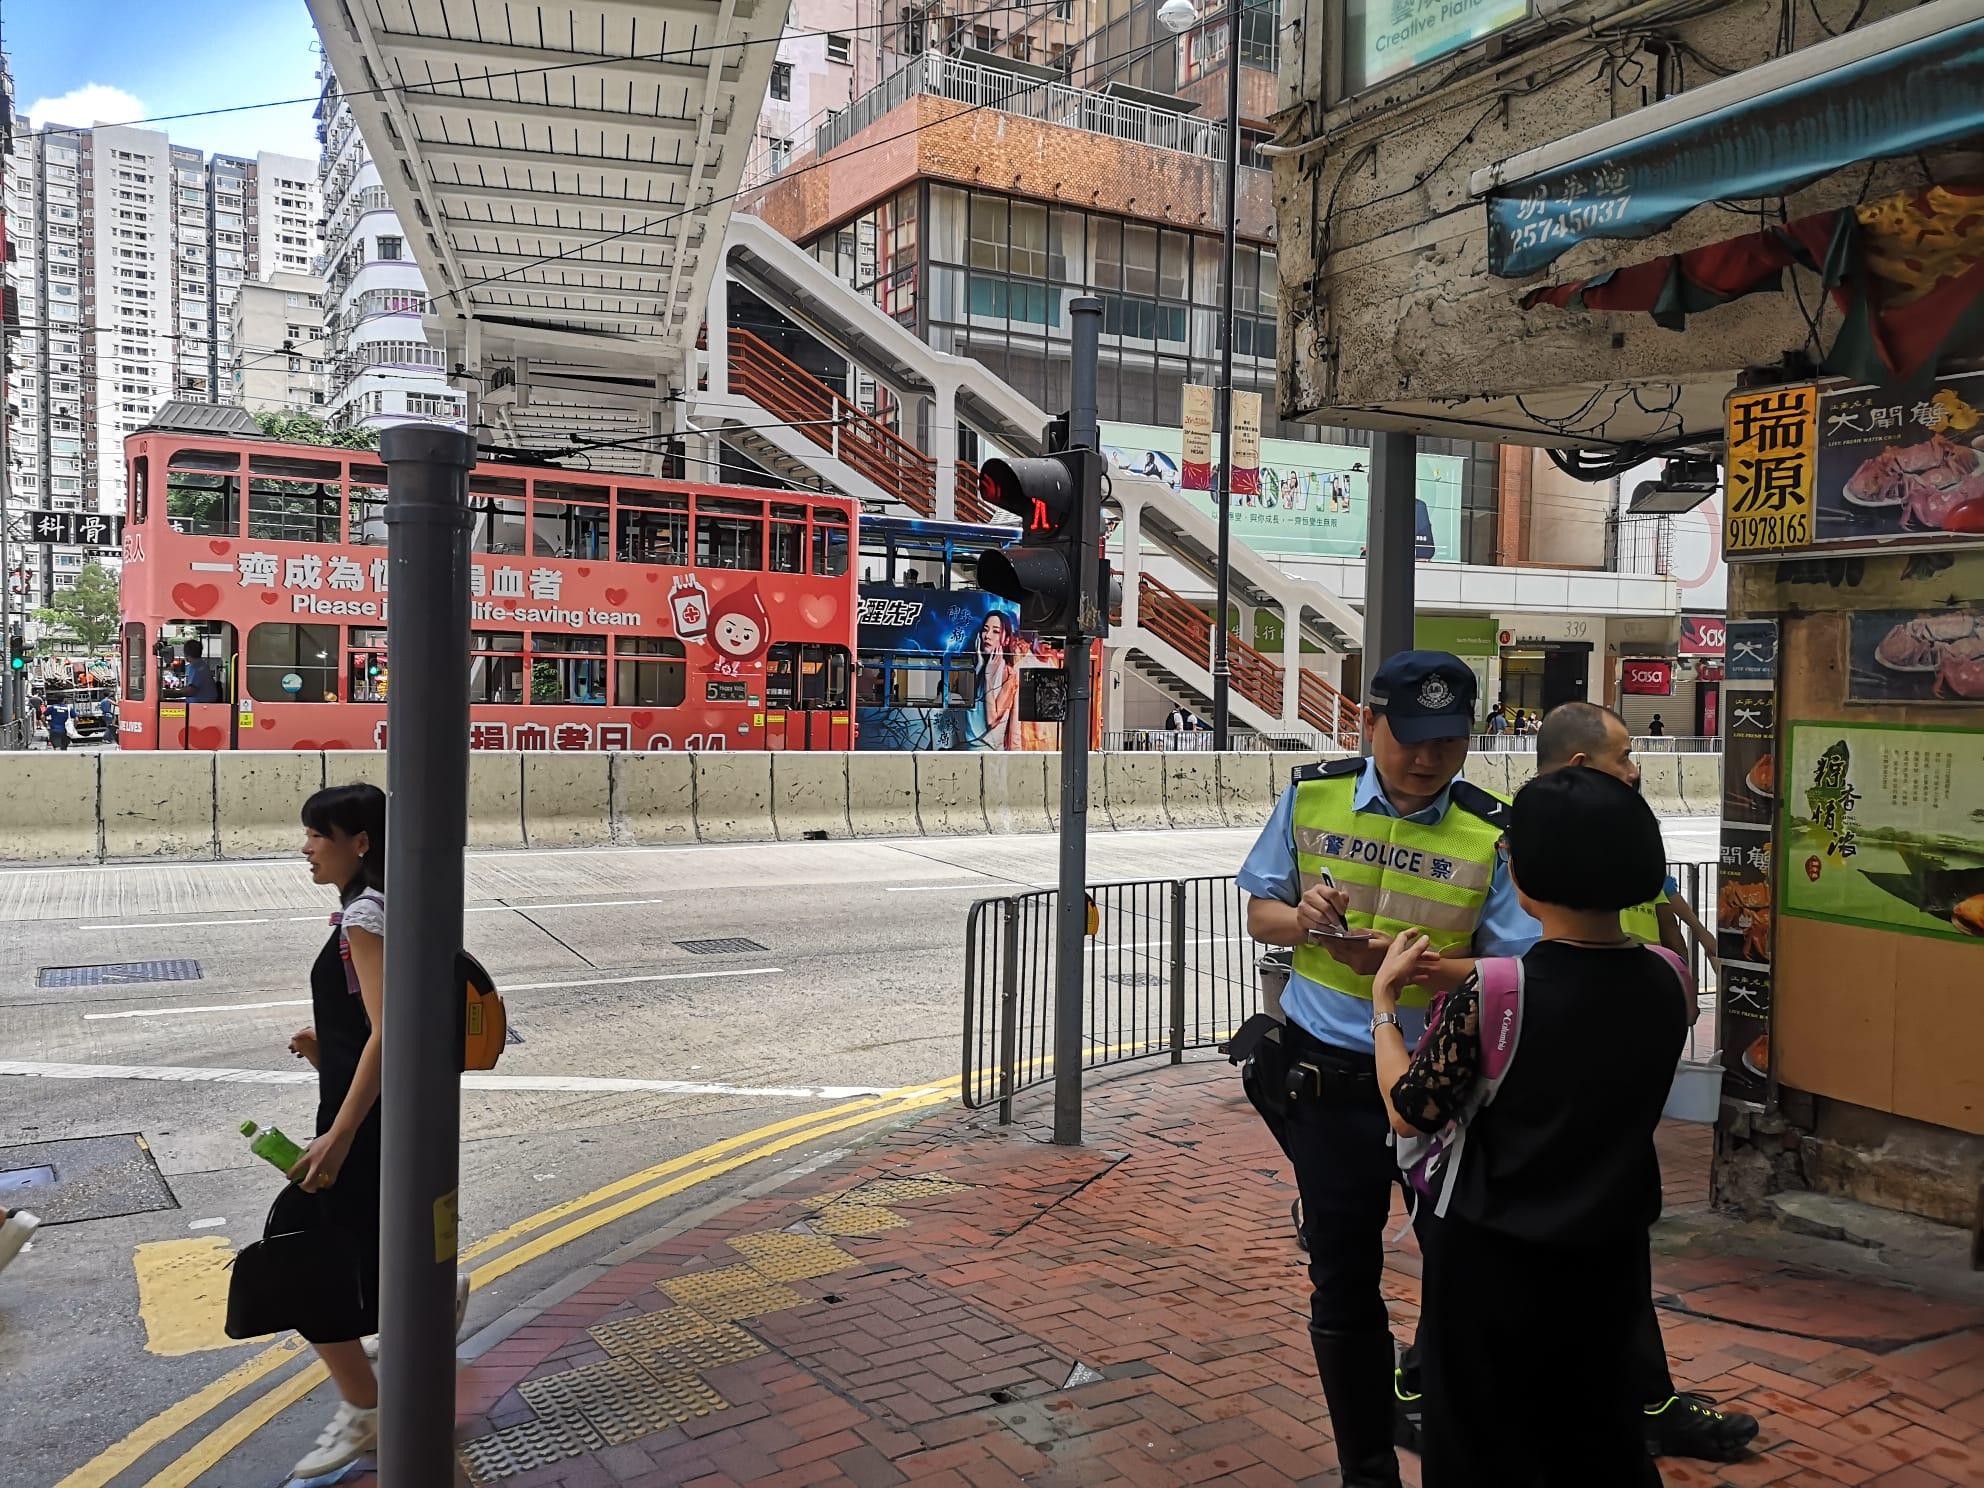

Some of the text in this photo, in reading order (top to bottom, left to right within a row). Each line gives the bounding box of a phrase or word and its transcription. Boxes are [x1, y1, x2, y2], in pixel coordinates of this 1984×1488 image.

[1375, 13, 1435, 52] Creative
[1510, 195, 1632, 253] 25745037
[1731, 392, 1810, 514] 瑞源
[1729, 513, 1807, 549] 91978165
[292, 594, 377, 616] Please
[471, 600, 584, 628] life-saving
[587, 606, 641, 626] team
[1563, 620, 1587, 639] 339
[1698, 625, 1726, 647] Sas
[1732, 640, 1778, 663] 大
[707, 683, 718, 699] 5
[1732, 708, 1774, 729] 大
[1325, 834, 1453, 880] 警 POLICE 察
[1497, 1016, 1512, 1051] Columbia
